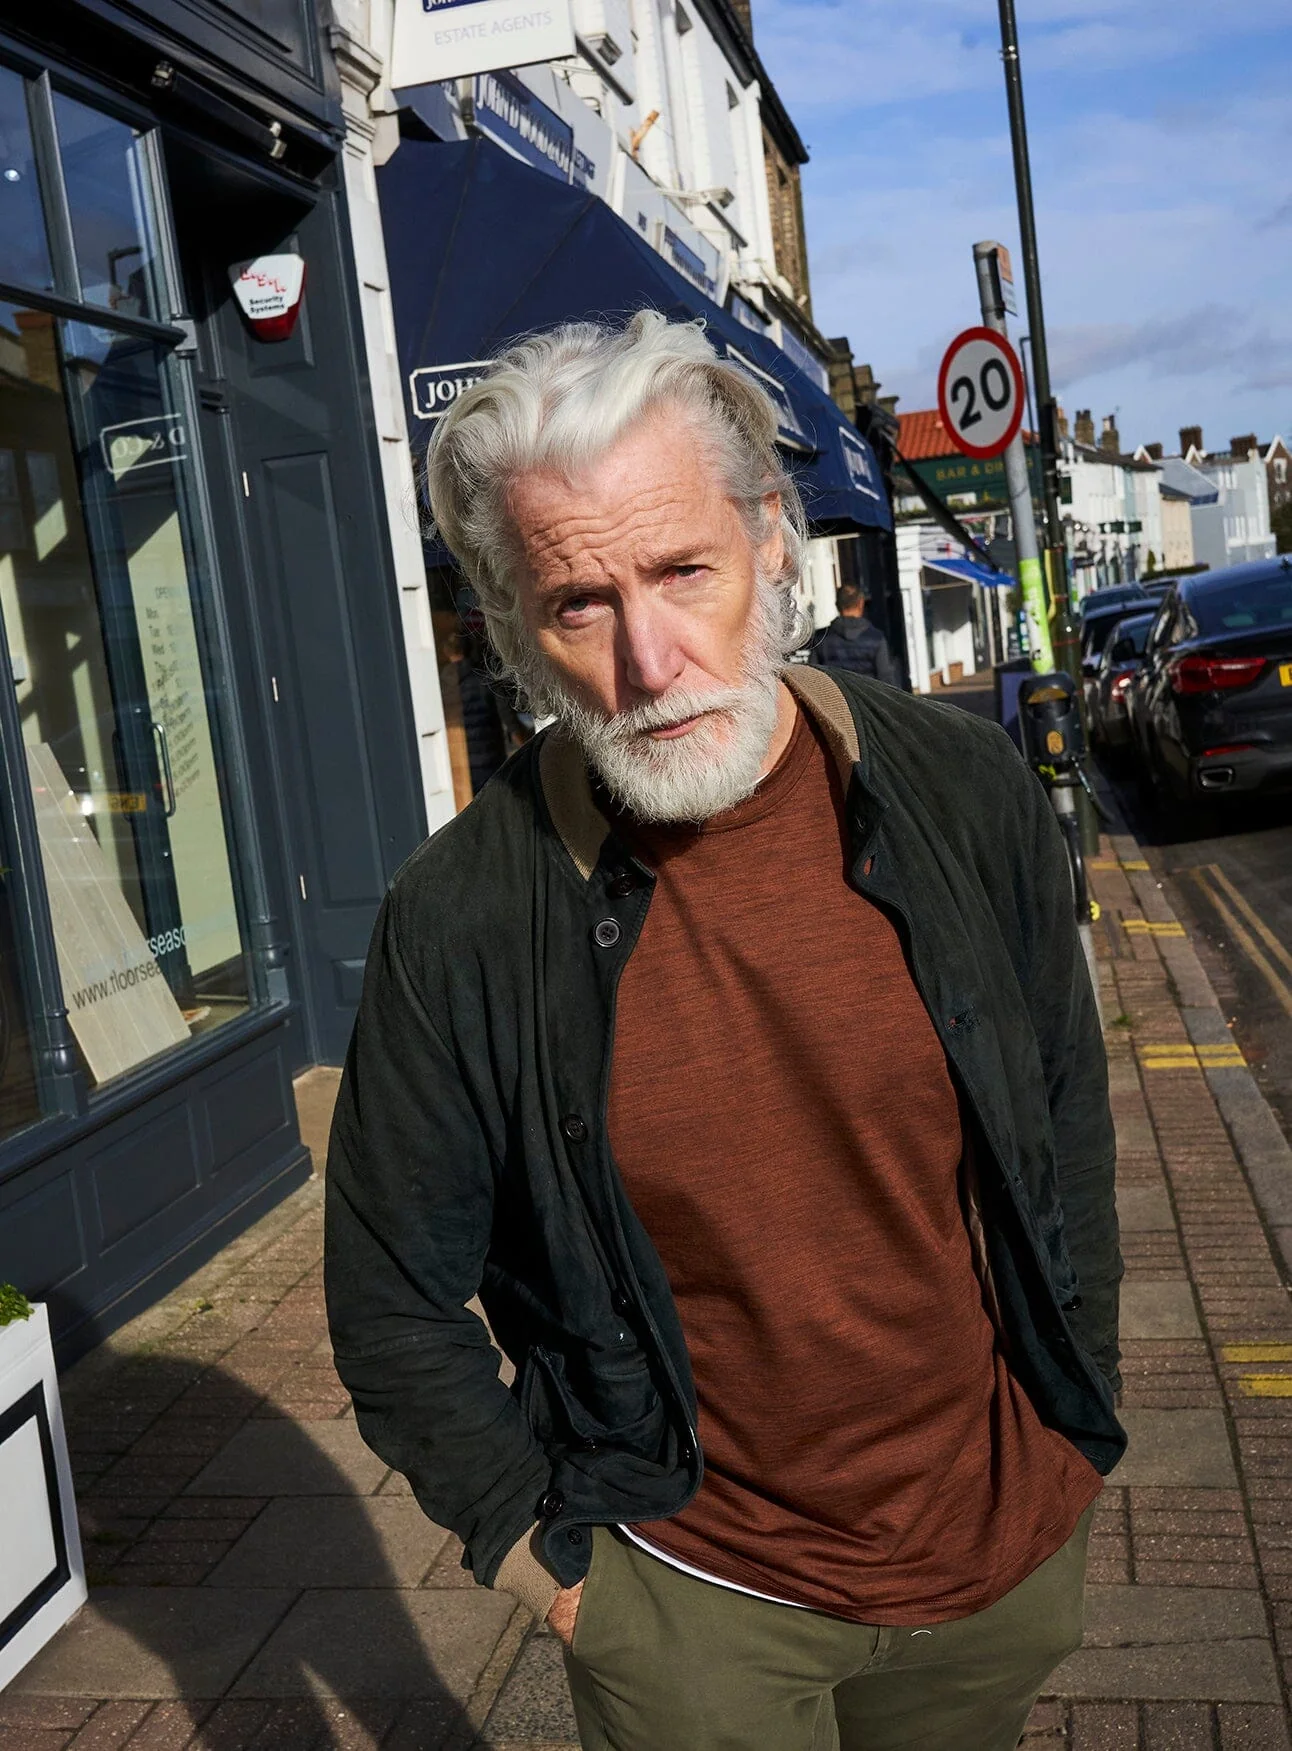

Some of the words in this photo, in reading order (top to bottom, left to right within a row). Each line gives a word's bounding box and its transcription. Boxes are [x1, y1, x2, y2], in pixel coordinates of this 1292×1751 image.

[434, 22, 488, 46] ESTATE
[490, 10, 554, 36] AGENTS
[249, 295, 284, 306] Security
[249, 303, 285, 314] Systems
[950, 357, 1011, 431] 20
[935, 465, 967, 481] BAR
[970, 463, 981, 477] &
